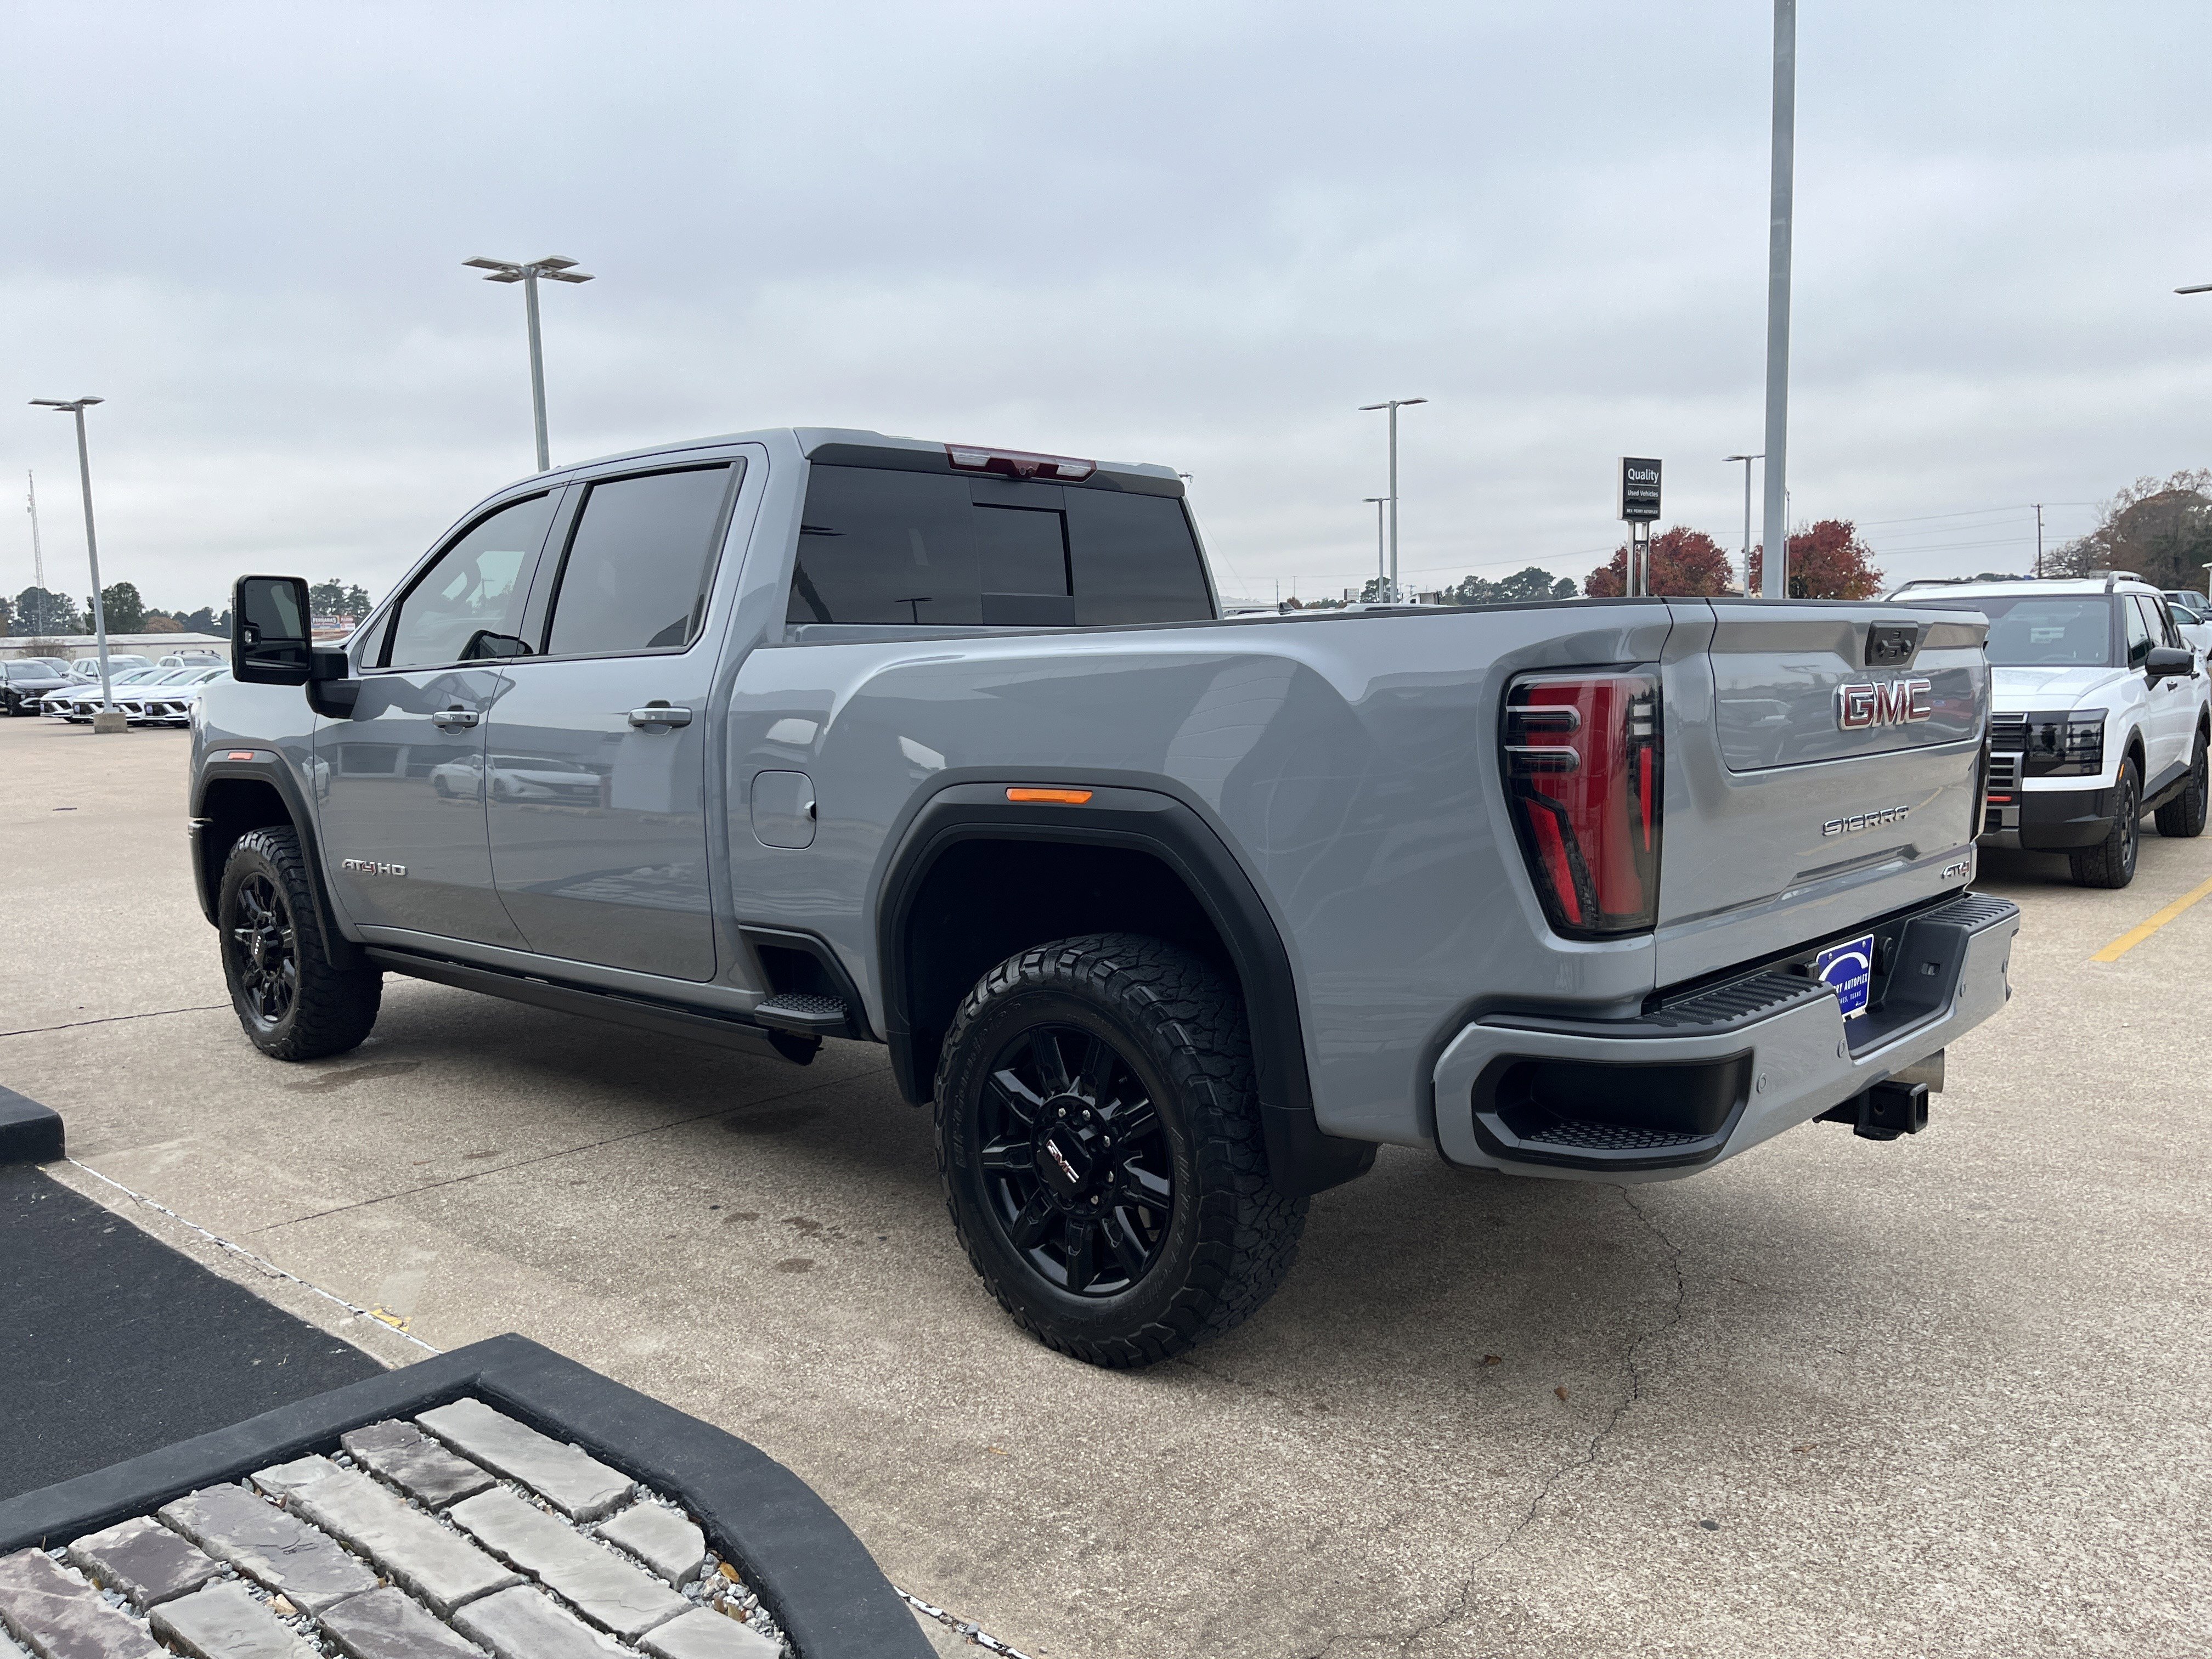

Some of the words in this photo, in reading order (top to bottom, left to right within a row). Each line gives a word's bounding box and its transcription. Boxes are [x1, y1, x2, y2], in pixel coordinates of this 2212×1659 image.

[1628, 469, 1659, 483] Quality
[1838, 678, 1931, 730] GMC
[1822, 805, 1909, 836] SIERRA
[1844, 973, 1868, 991] AUTOPLEX
[1850, 990, 1861, 1000] TEXAS
[1046, 1139, 1080, 1184] GMC
